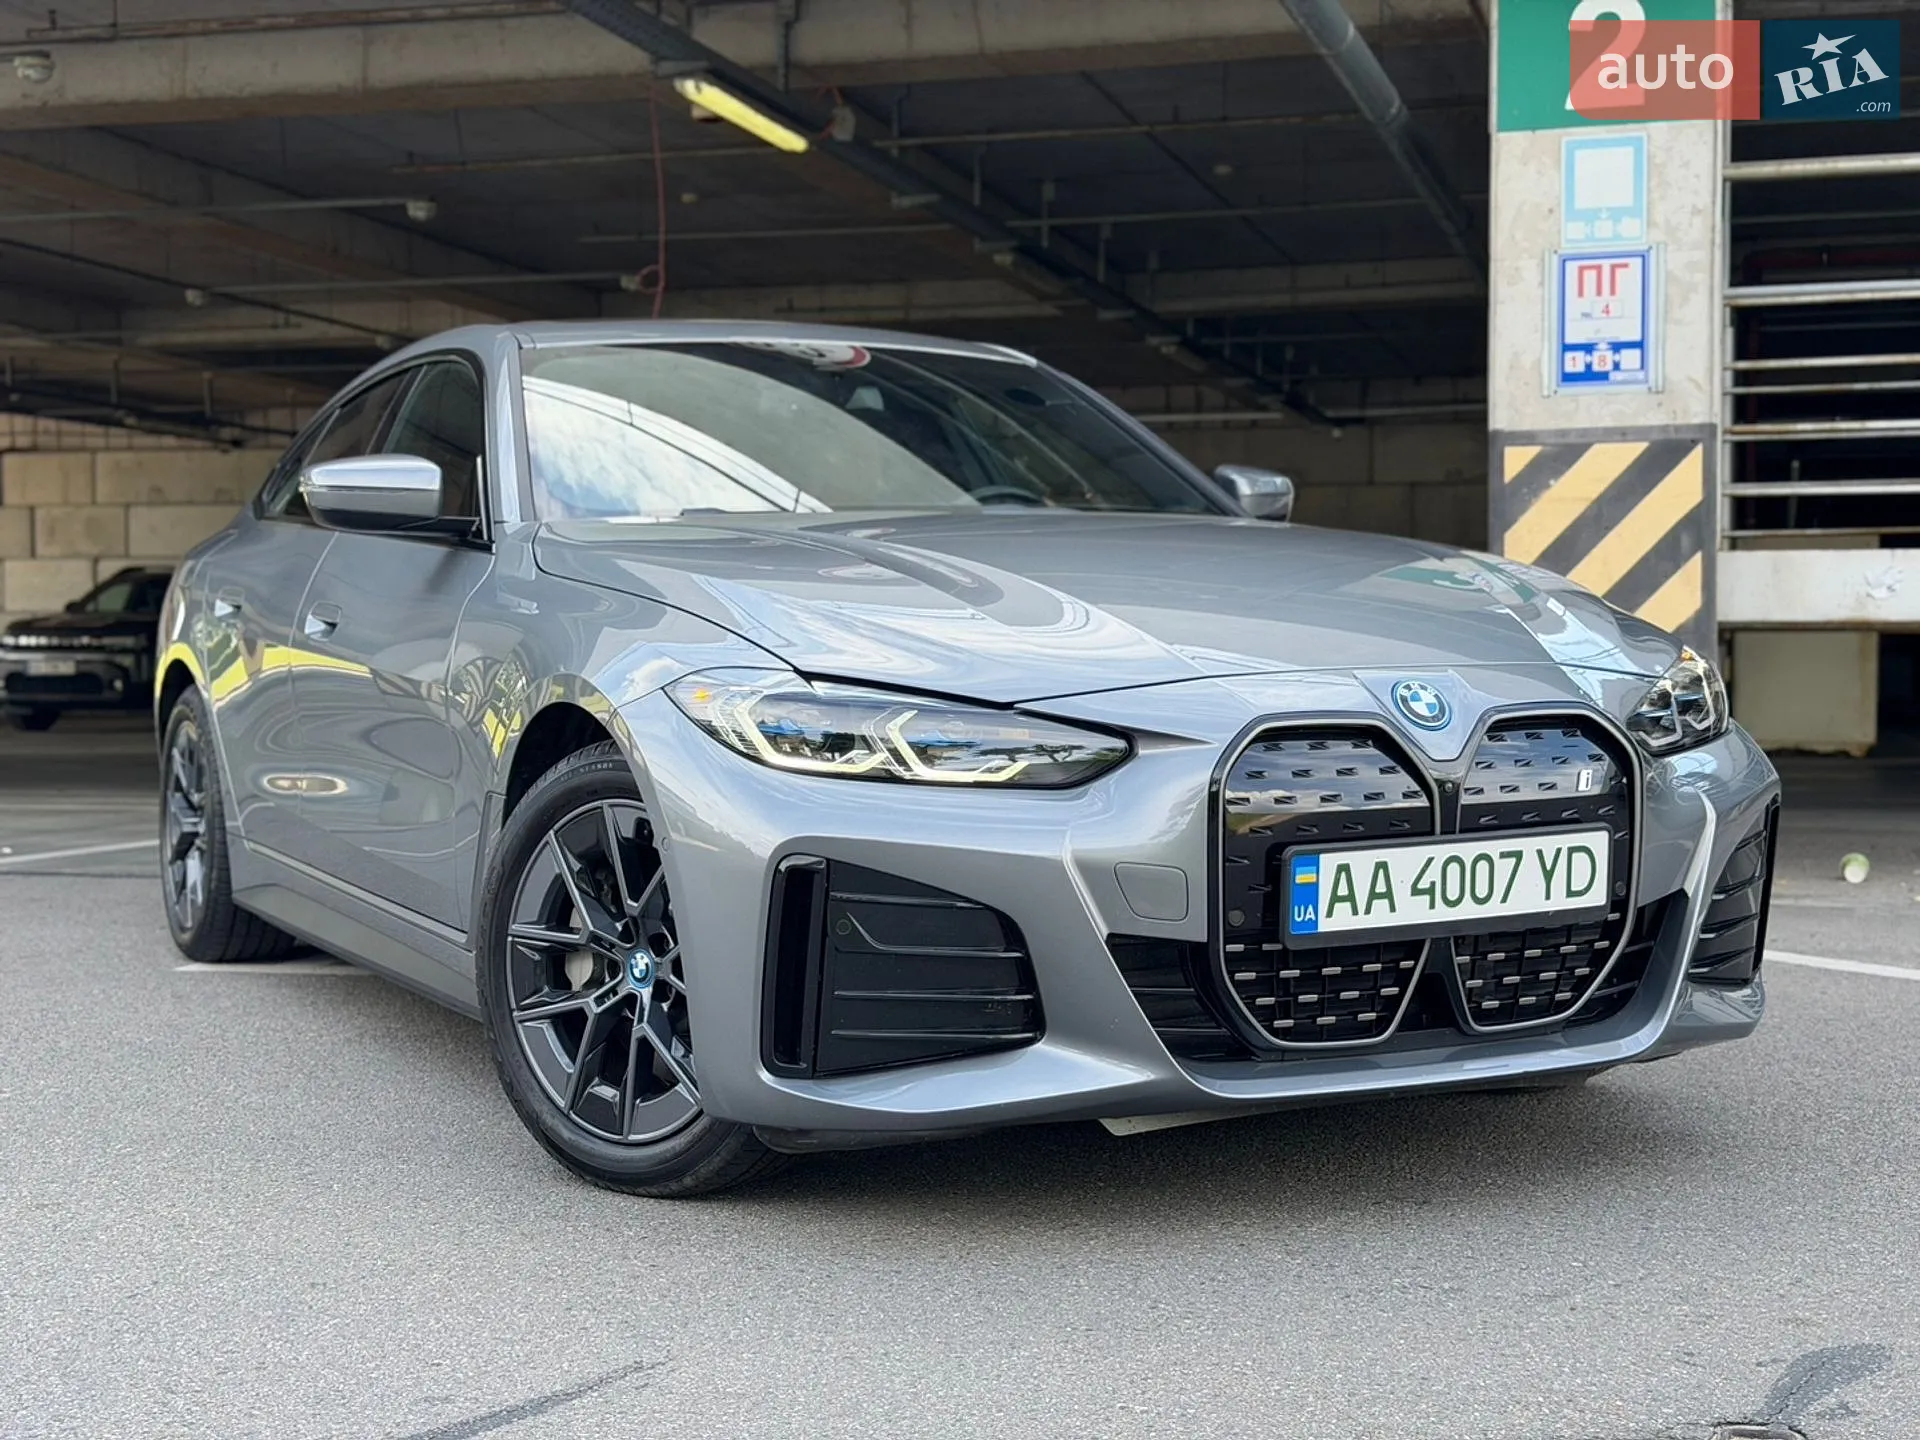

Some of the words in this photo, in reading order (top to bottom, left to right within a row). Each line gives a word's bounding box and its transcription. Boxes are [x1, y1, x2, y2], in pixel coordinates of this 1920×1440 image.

[1565, 0, 1646, 111] 2
[1578, 263, 1629, 298] ПГ
[1601, 303, 1611, 316] 4
[1400, 682, 1438, 697] BMW
[1325, 861, 1397, 919] AA
[1410, 850, 1524, 910] 4007
[1536, 845, 1597, 901] YD
[1294, 904, 1316, 922] UA
